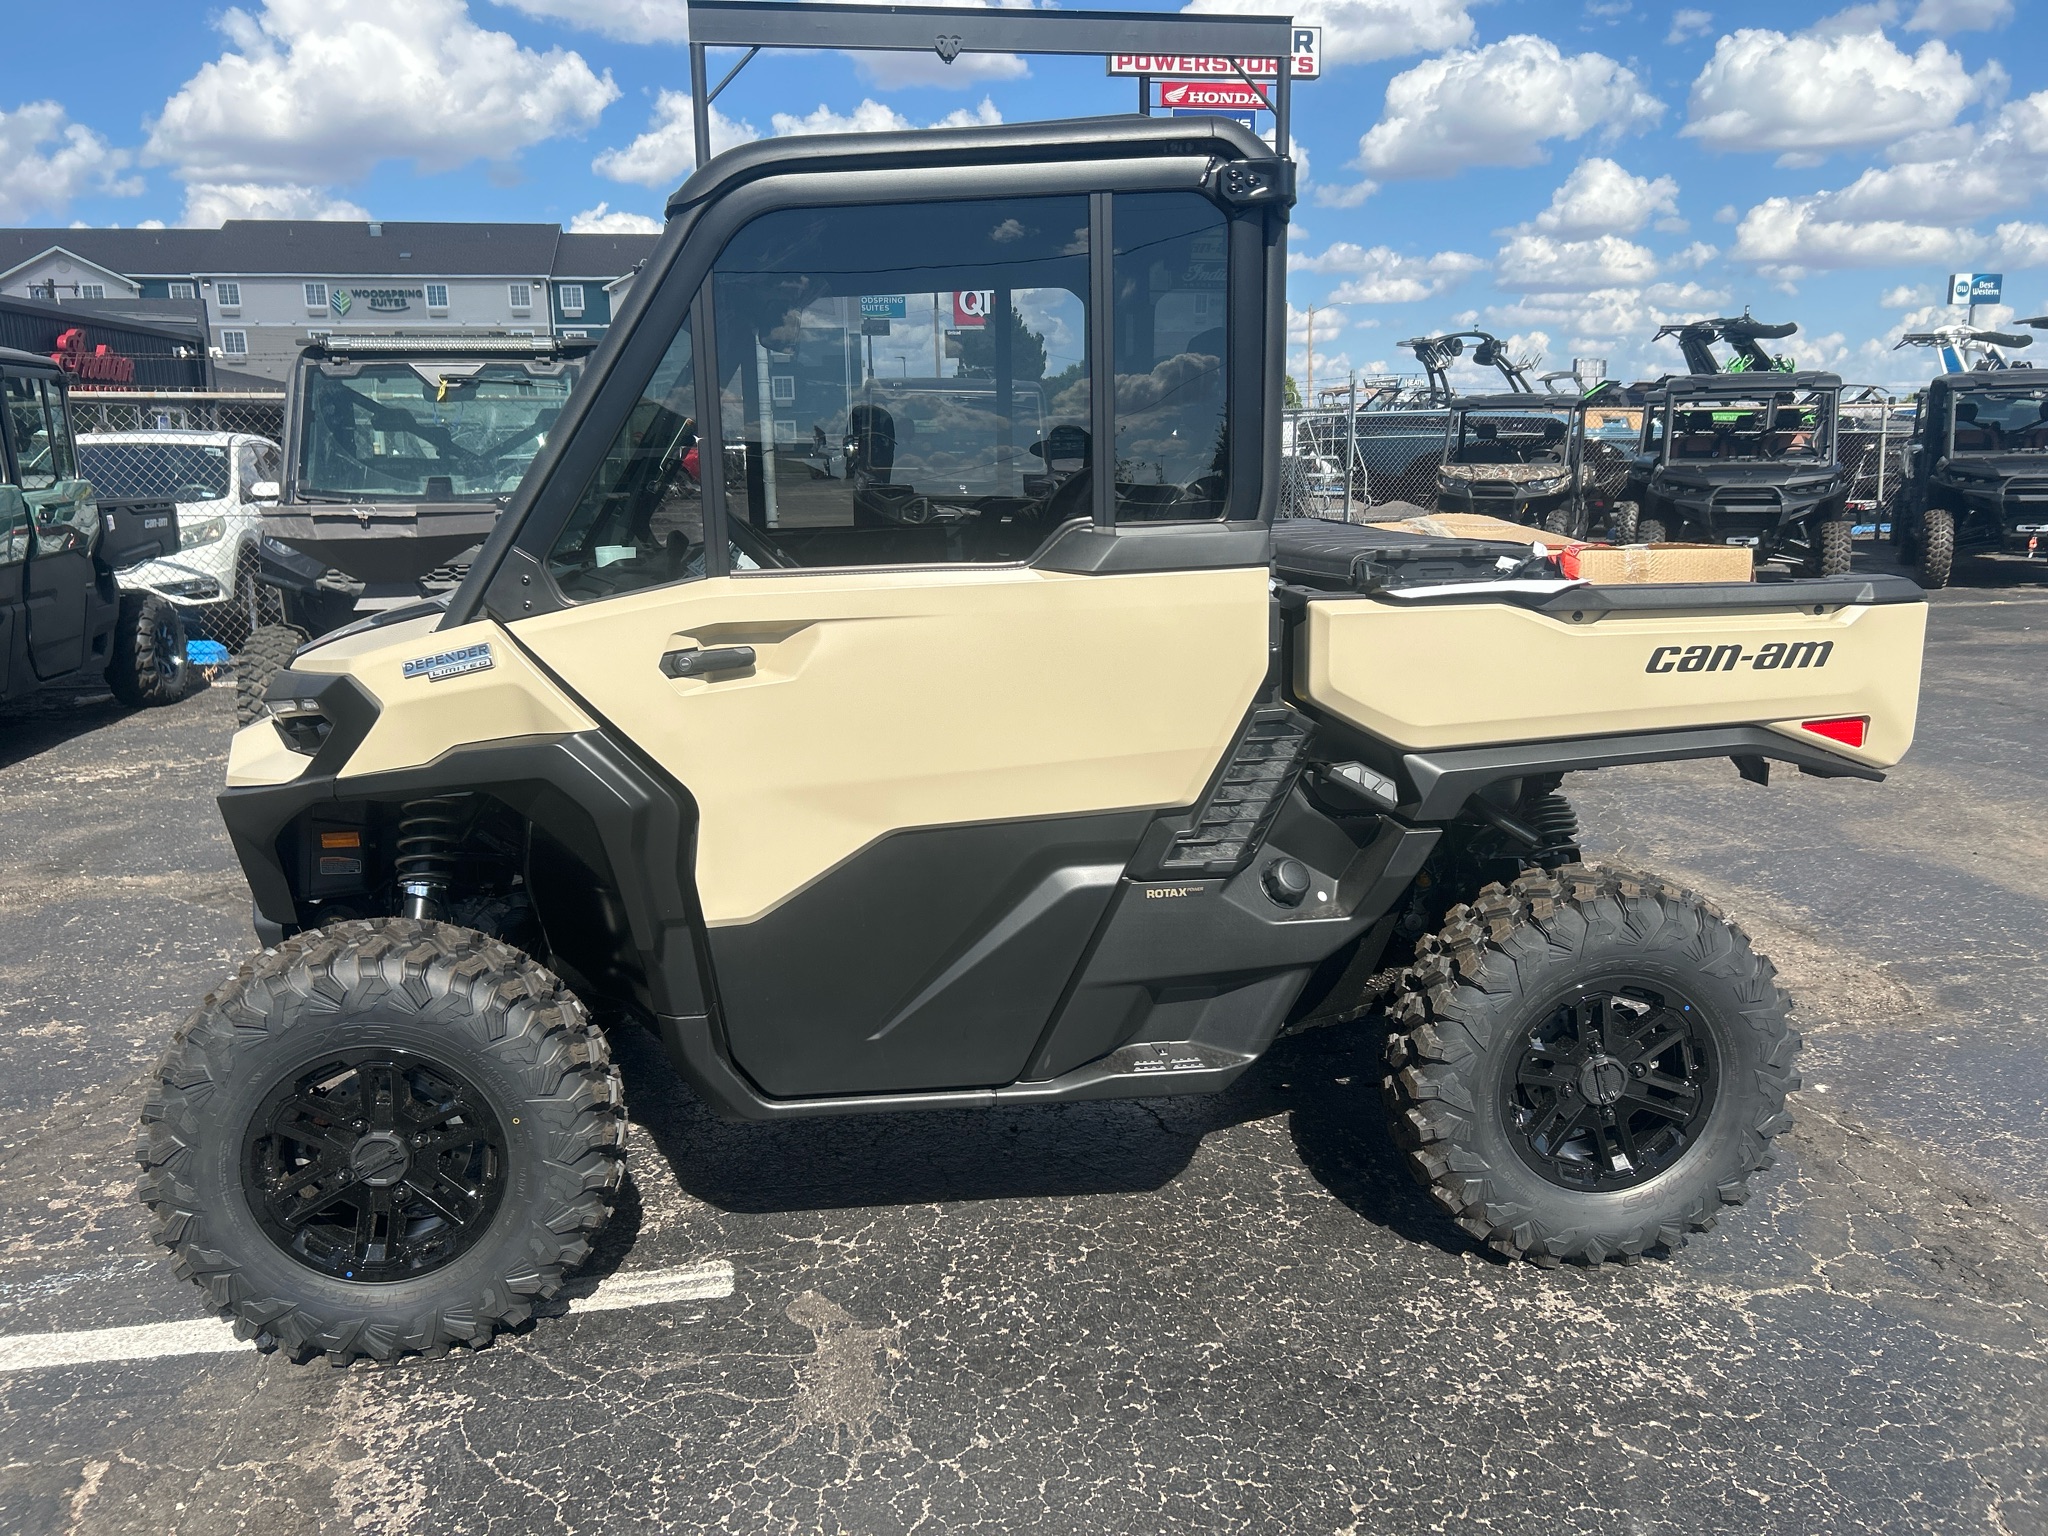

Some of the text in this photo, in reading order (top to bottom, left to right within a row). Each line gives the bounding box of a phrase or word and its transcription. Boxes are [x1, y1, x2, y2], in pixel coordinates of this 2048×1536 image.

[1117, 56, 1314, 73] POWERSPORS
[1188, 91, 1264, 104] HONDA
[1979, 281, 1995, 289] Best
[351, 289, 423, 299] WOODSPRING
[1972, 287, 1999, 296] Western
[370, 298, 407, 307] SUITES
[861, 304, 890, 312] SUITES
[958, 290, 995, 318] QT
[144, 517, 168, 529] can-am
[404, 644, 489, 672] DEFENDER
[1645, 640, 1834, 674] can-am
[432, 660, 488, 677] LIMITED
[1146, 887, 1187, 899] ROTAX
